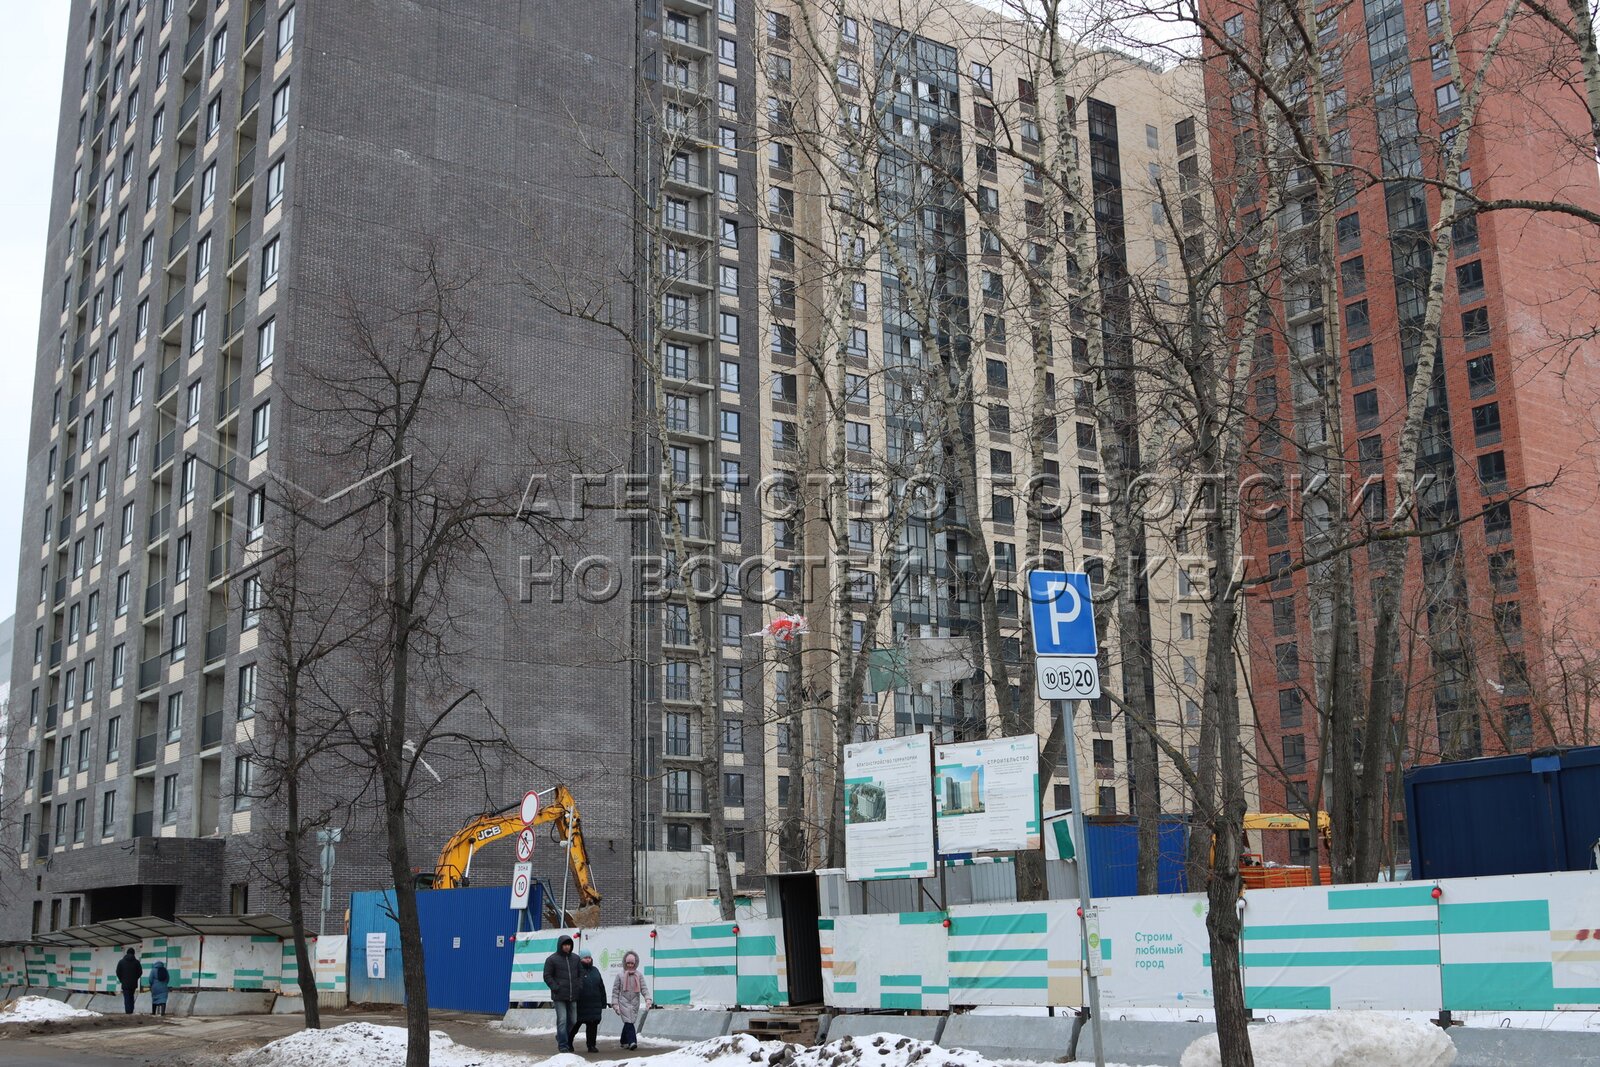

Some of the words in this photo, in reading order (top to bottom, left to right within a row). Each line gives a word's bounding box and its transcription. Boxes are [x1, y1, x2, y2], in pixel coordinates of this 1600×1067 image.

[1046, 580, 1082, 645] P
[1045, 672, 1056, 684] 10
[1059, 671, 1070, 685] 15
[1075, 669, 1093, 687] 20
[987, 755, 1030, 765] СТРОИТЕЛЬСТВО
[477, 826, 501, 840] JCB
[518, 881, 525, 891] 10
[1135, 932, 1173, 944] Строим
[1135, 944, 1183, 955] любимый
[1135, 960, 1165, 970] город
